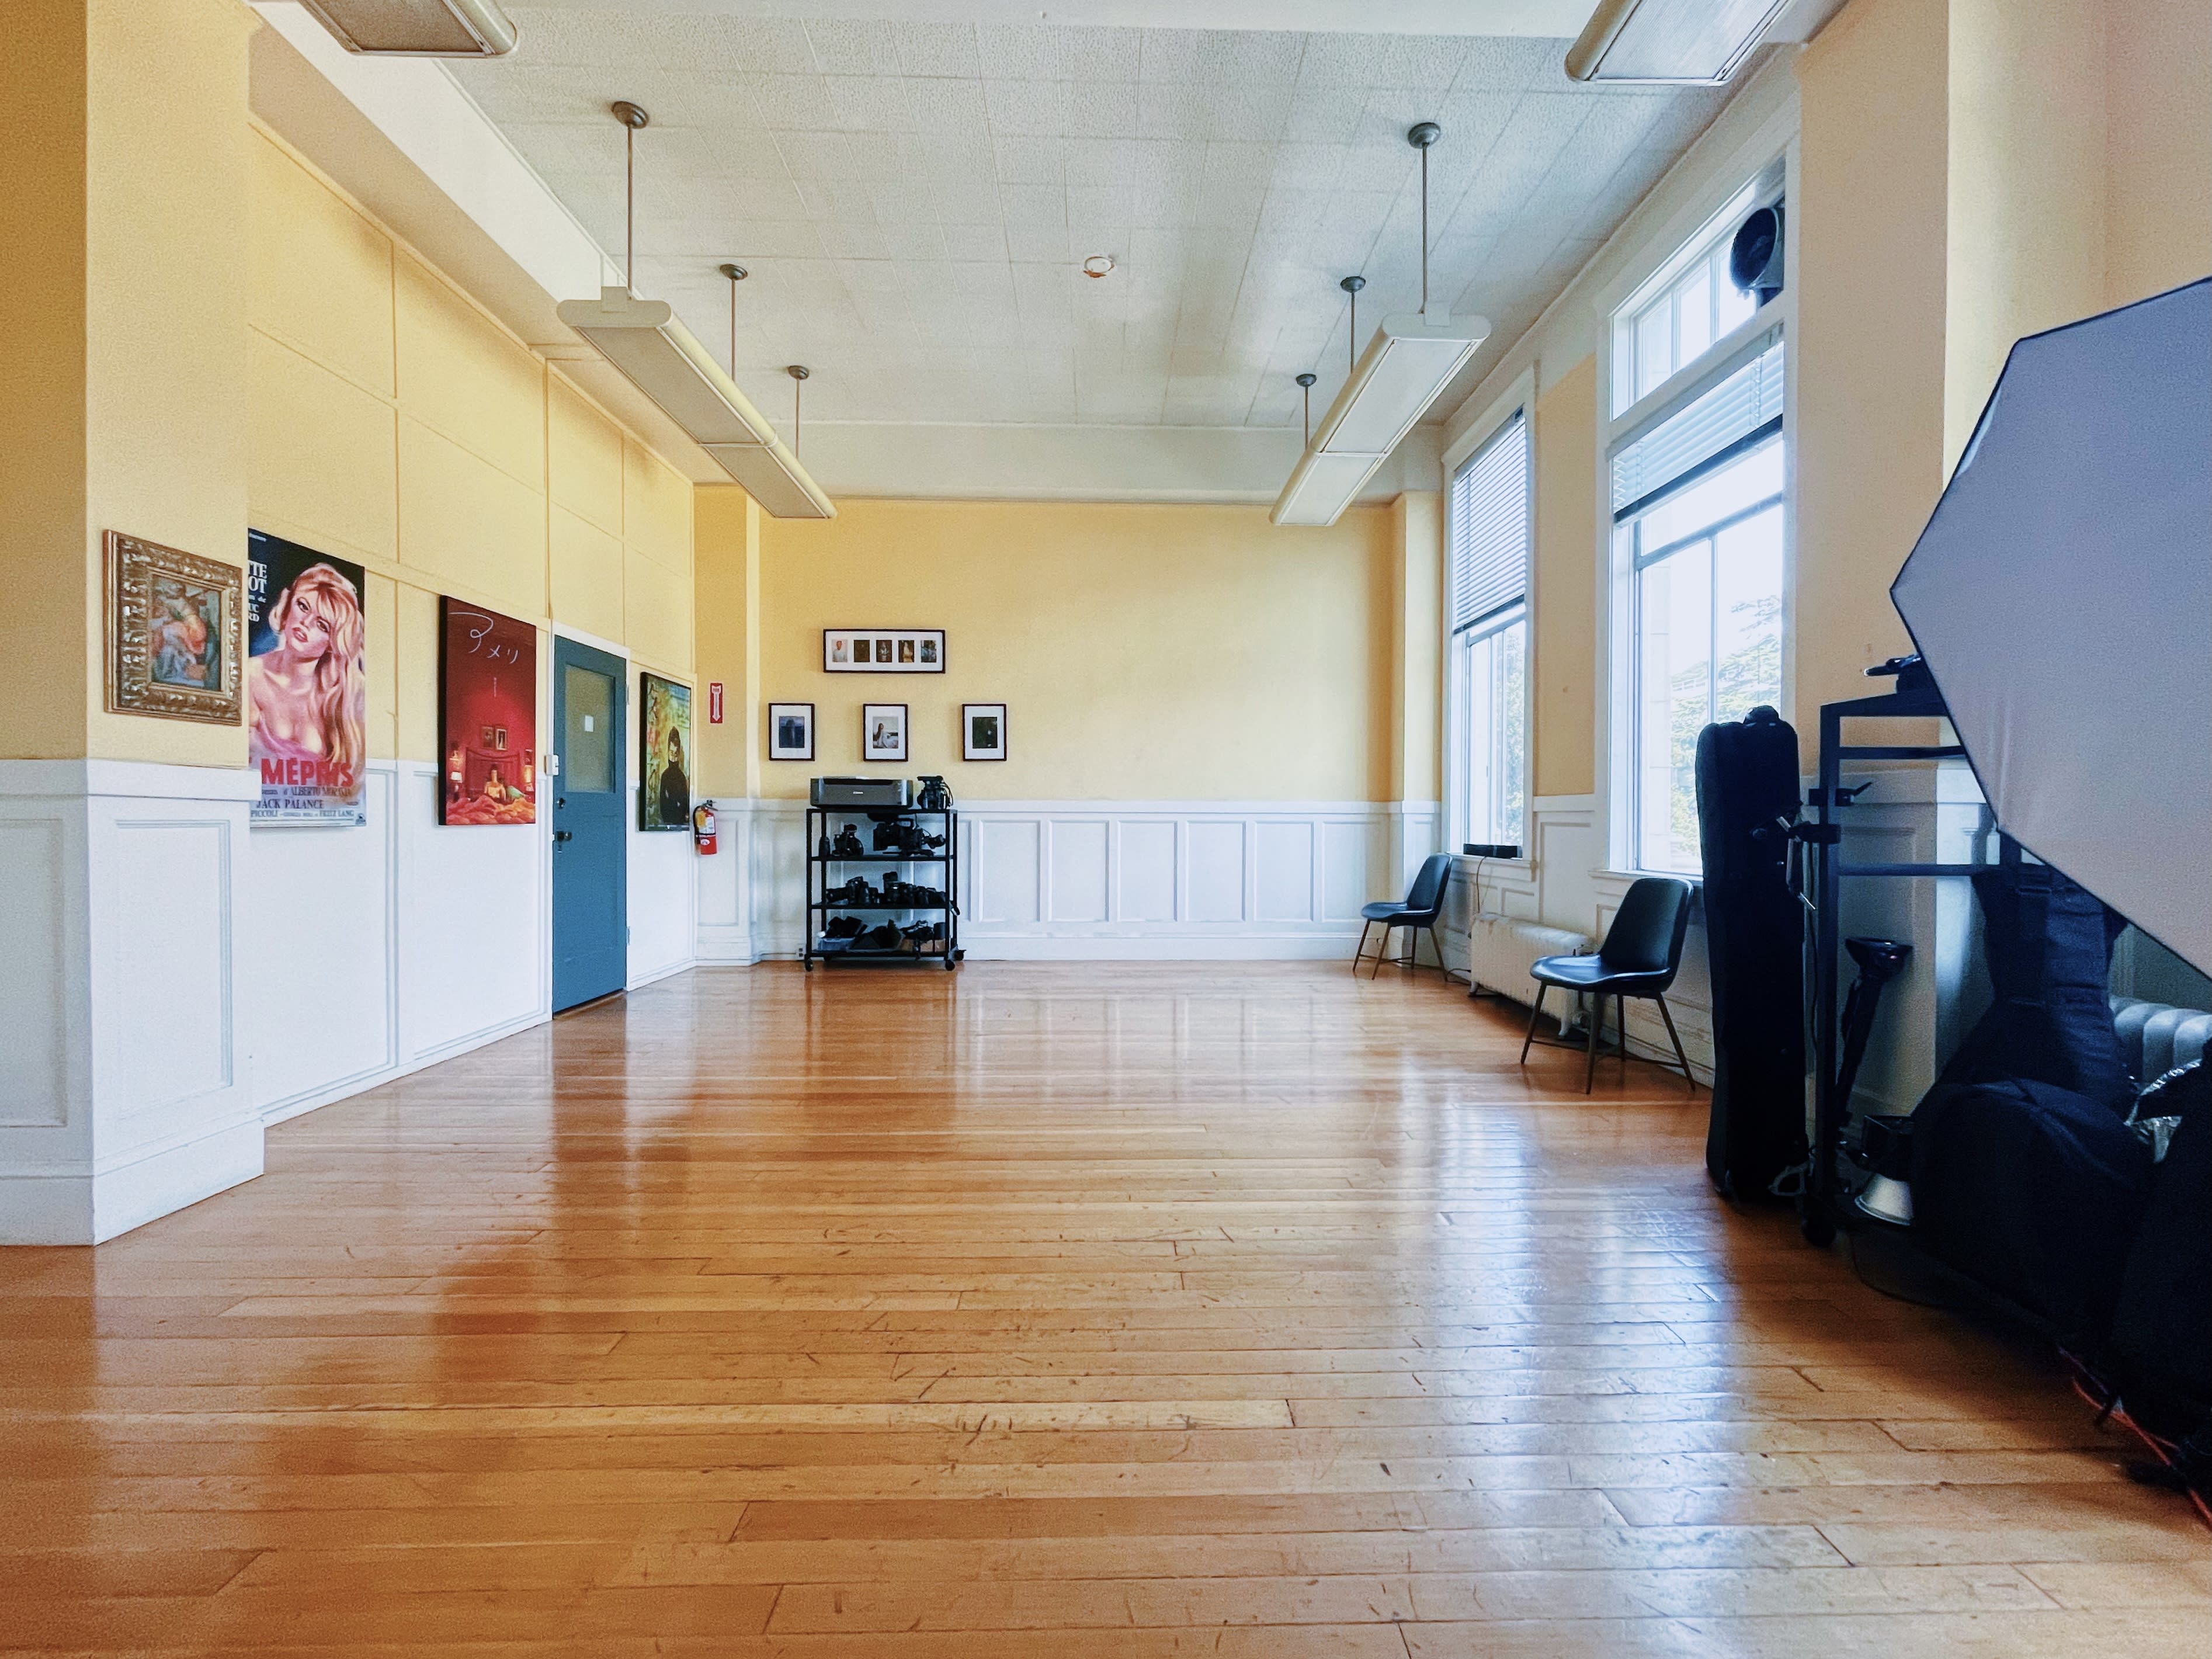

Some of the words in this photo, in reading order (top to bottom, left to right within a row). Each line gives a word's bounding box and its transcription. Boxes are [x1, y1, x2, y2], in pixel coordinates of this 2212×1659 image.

[248, 576, 267, 594] OT
[256, 799, 281, 809] JACK
[285, 799, 323, 809] PALANCE
